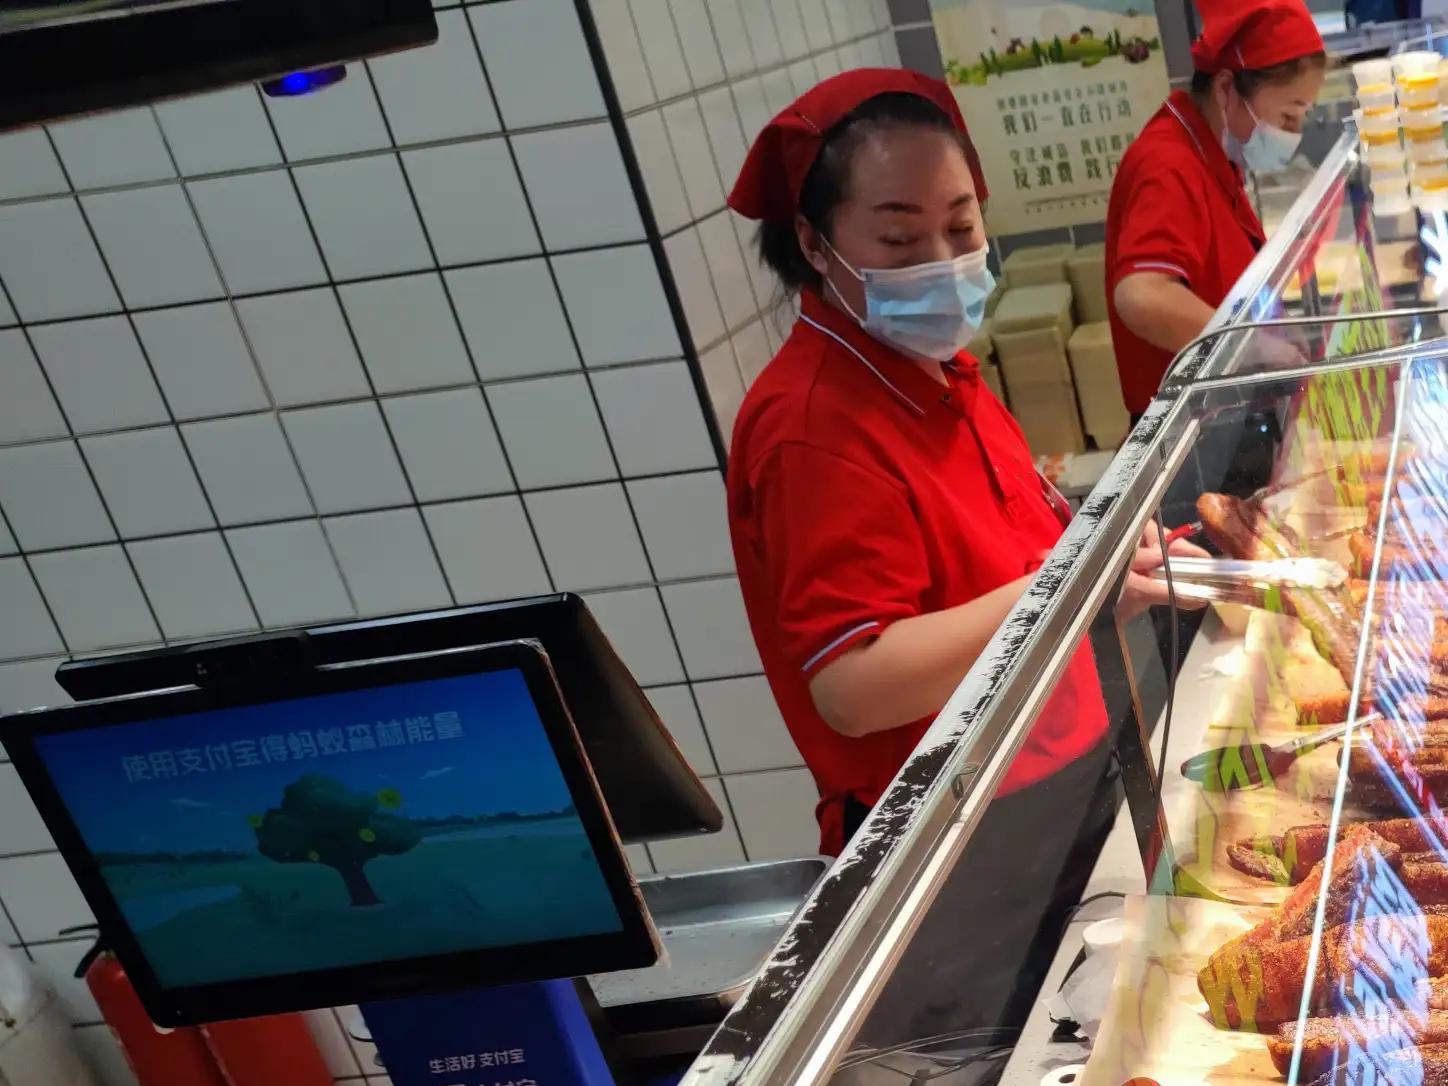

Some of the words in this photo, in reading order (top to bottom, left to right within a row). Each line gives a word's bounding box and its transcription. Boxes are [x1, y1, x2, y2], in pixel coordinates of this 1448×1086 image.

[1003, 97, 1131, 135] 我们一直在行动
[1013, 161, 1074, 190] 反浪费
[121, 711, 464, 783] 使用支付宝得蚂蚁森林能量
[429, 1054, 476, 1074] 生活好
[479, 1049, 525, 1067] 支付宝
